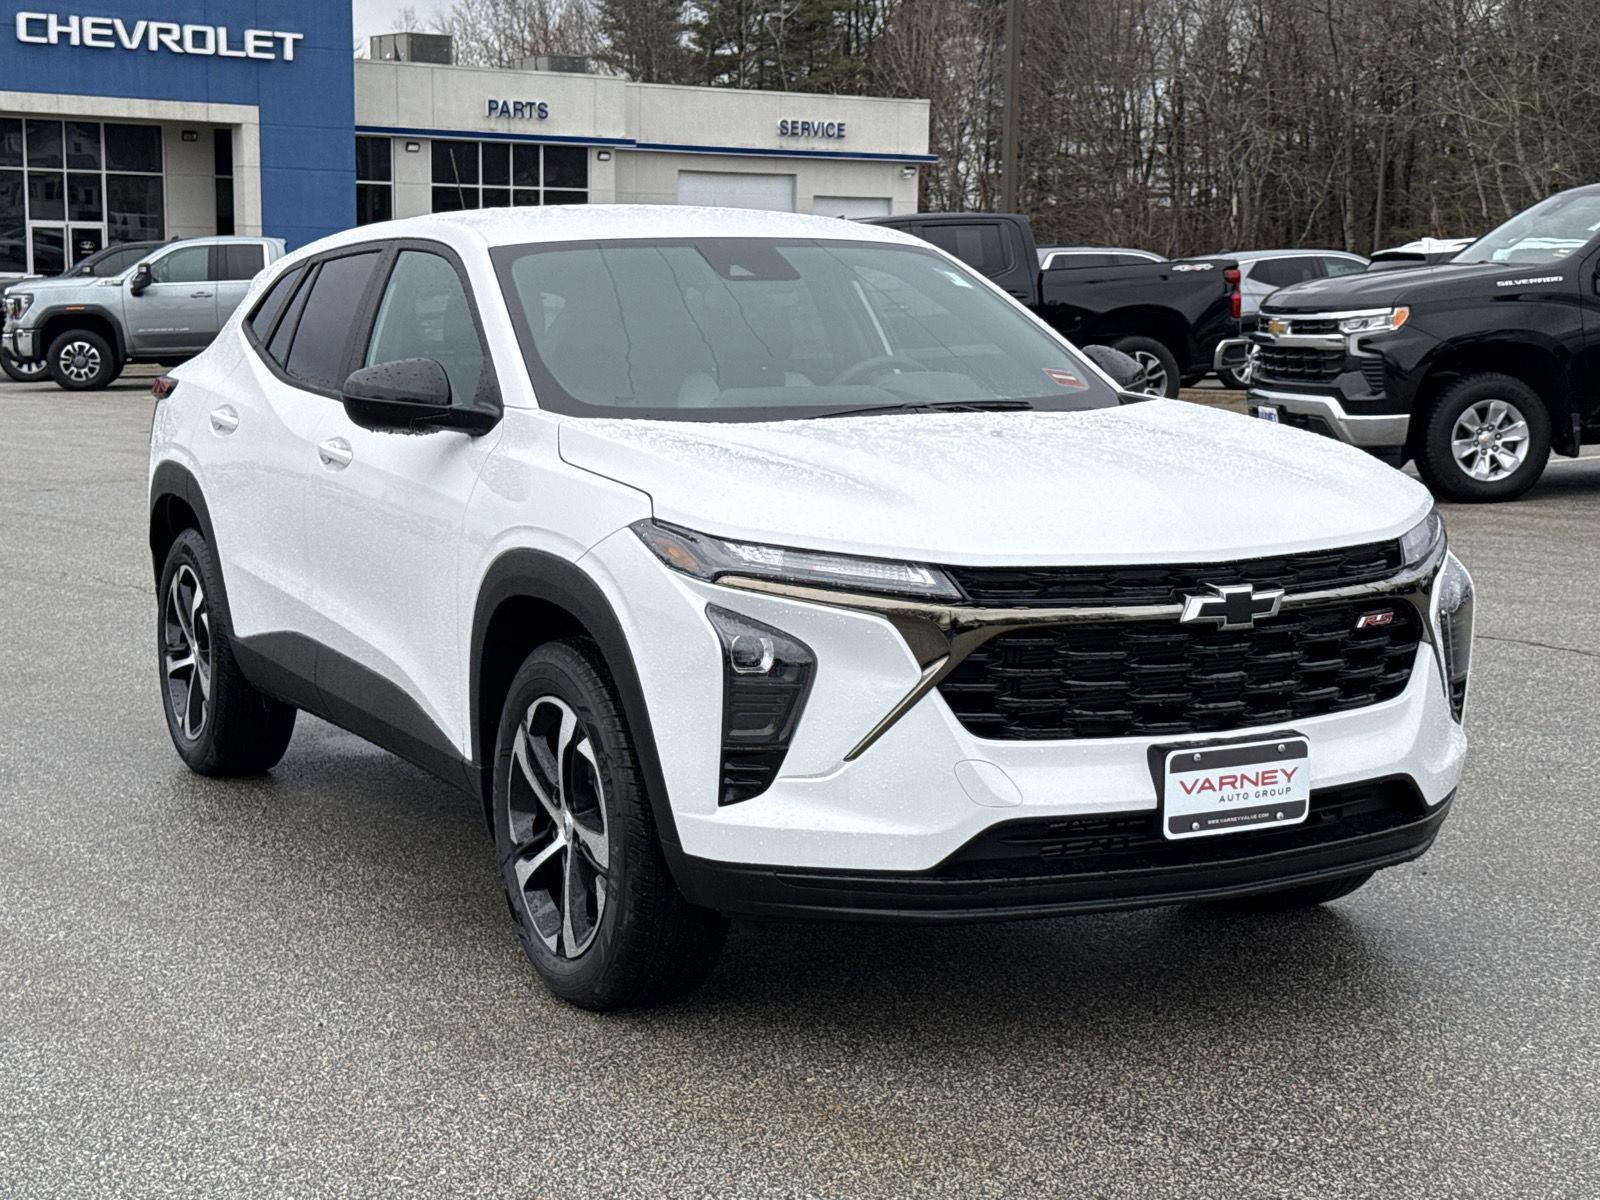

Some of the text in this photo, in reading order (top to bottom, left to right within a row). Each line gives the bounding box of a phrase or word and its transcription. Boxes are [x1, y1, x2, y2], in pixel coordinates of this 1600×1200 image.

[16, 11, 304, 61] CHEVROLET
[487, 99, 549, 120] PARTS
[779, 119, 846, 138] SERVICE
[1496, 276, 1563, 287] SILVERADO
[1357, 611, 1394, 628] RS
[1179, 766, 1299, 796] VARNEY
[1219, 787, 1292, 803] AUTO GROUP
